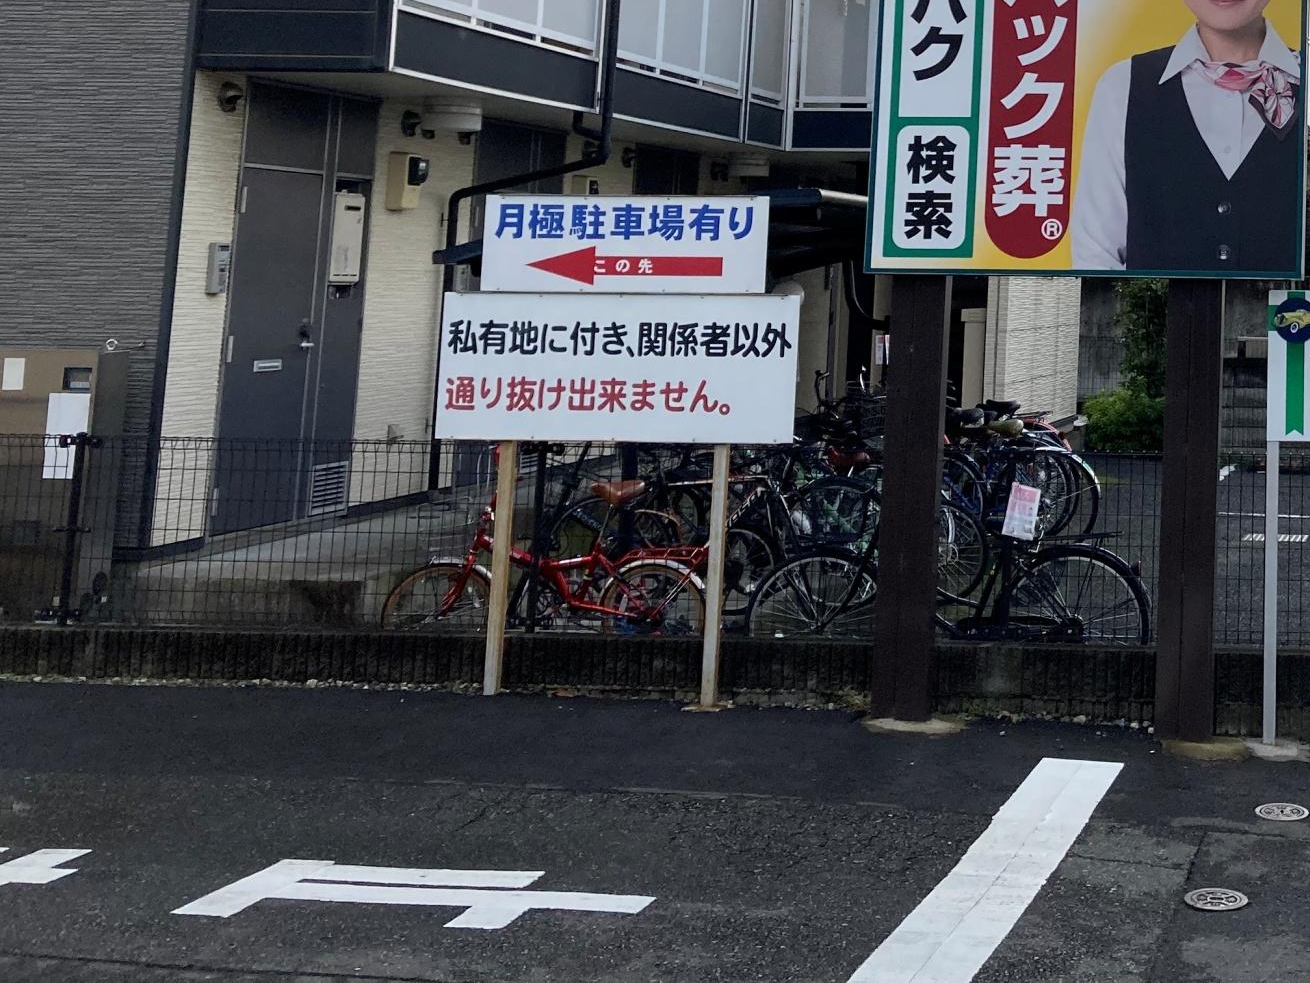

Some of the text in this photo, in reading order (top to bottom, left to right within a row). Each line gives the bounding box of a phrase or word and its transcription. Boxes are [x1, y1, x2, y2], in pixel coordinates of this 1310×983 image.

[904, 134, 958, 240] 検索
[495, 203, 755, 241] 月極駐車場有り
[593, 258, 654, 274] この先
[444, 376, 731, 416] 通り抜け出来ません。
